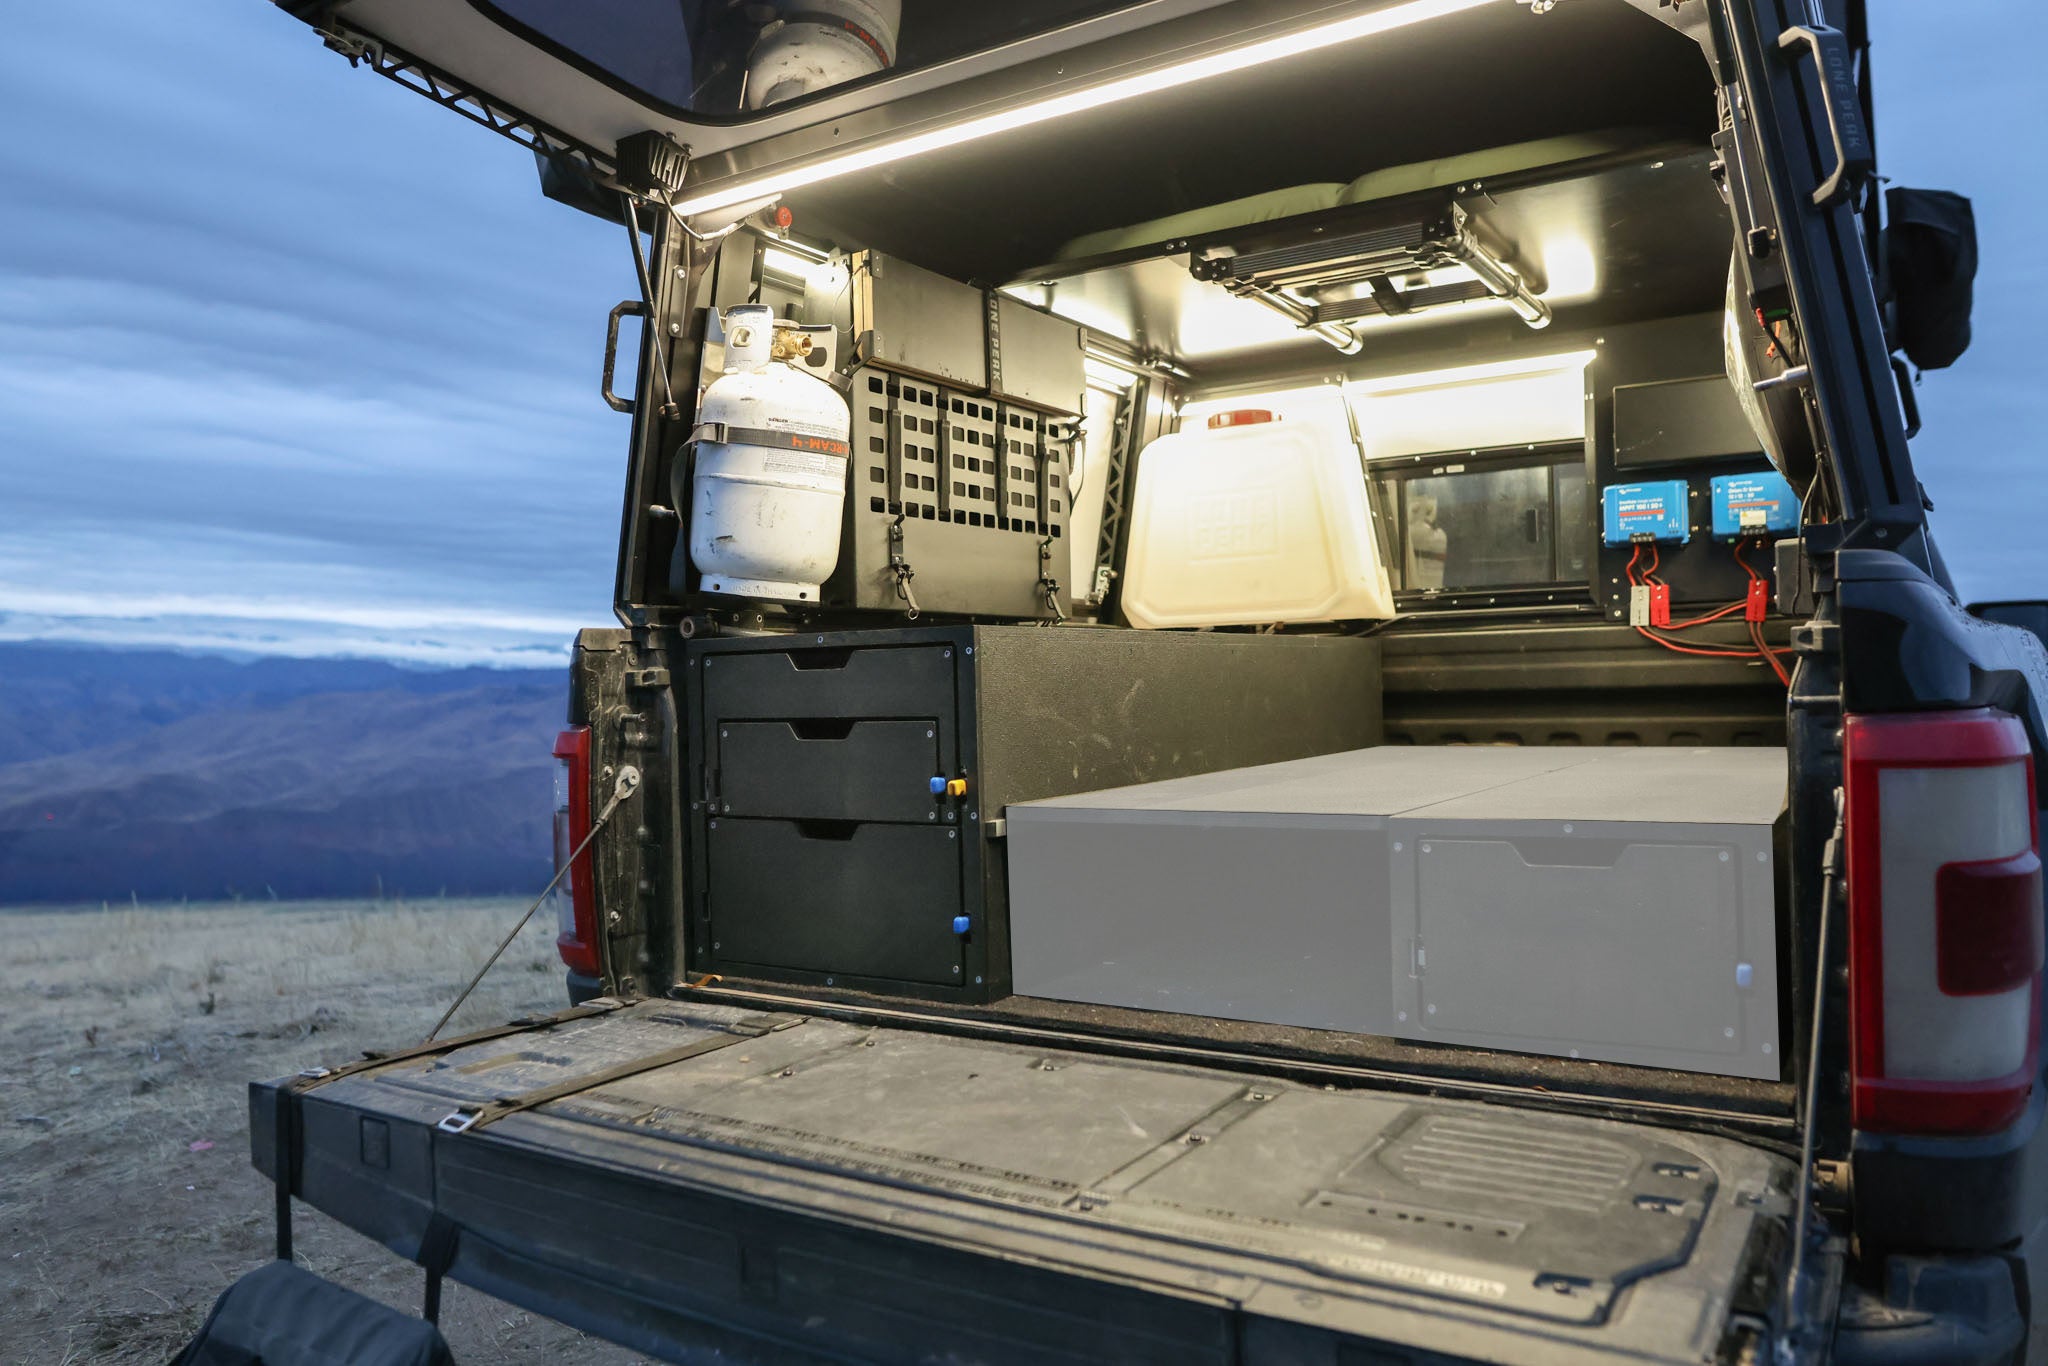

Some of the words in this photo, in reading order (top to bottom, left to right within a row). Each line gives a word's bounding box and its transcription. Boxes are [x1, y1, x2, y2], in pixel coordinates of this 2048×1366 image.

[1826, 47, 1847, 93] LONE
[1840, 99, 1861, 148] PEAK
[991, 338, 1001, 382] PEAK
